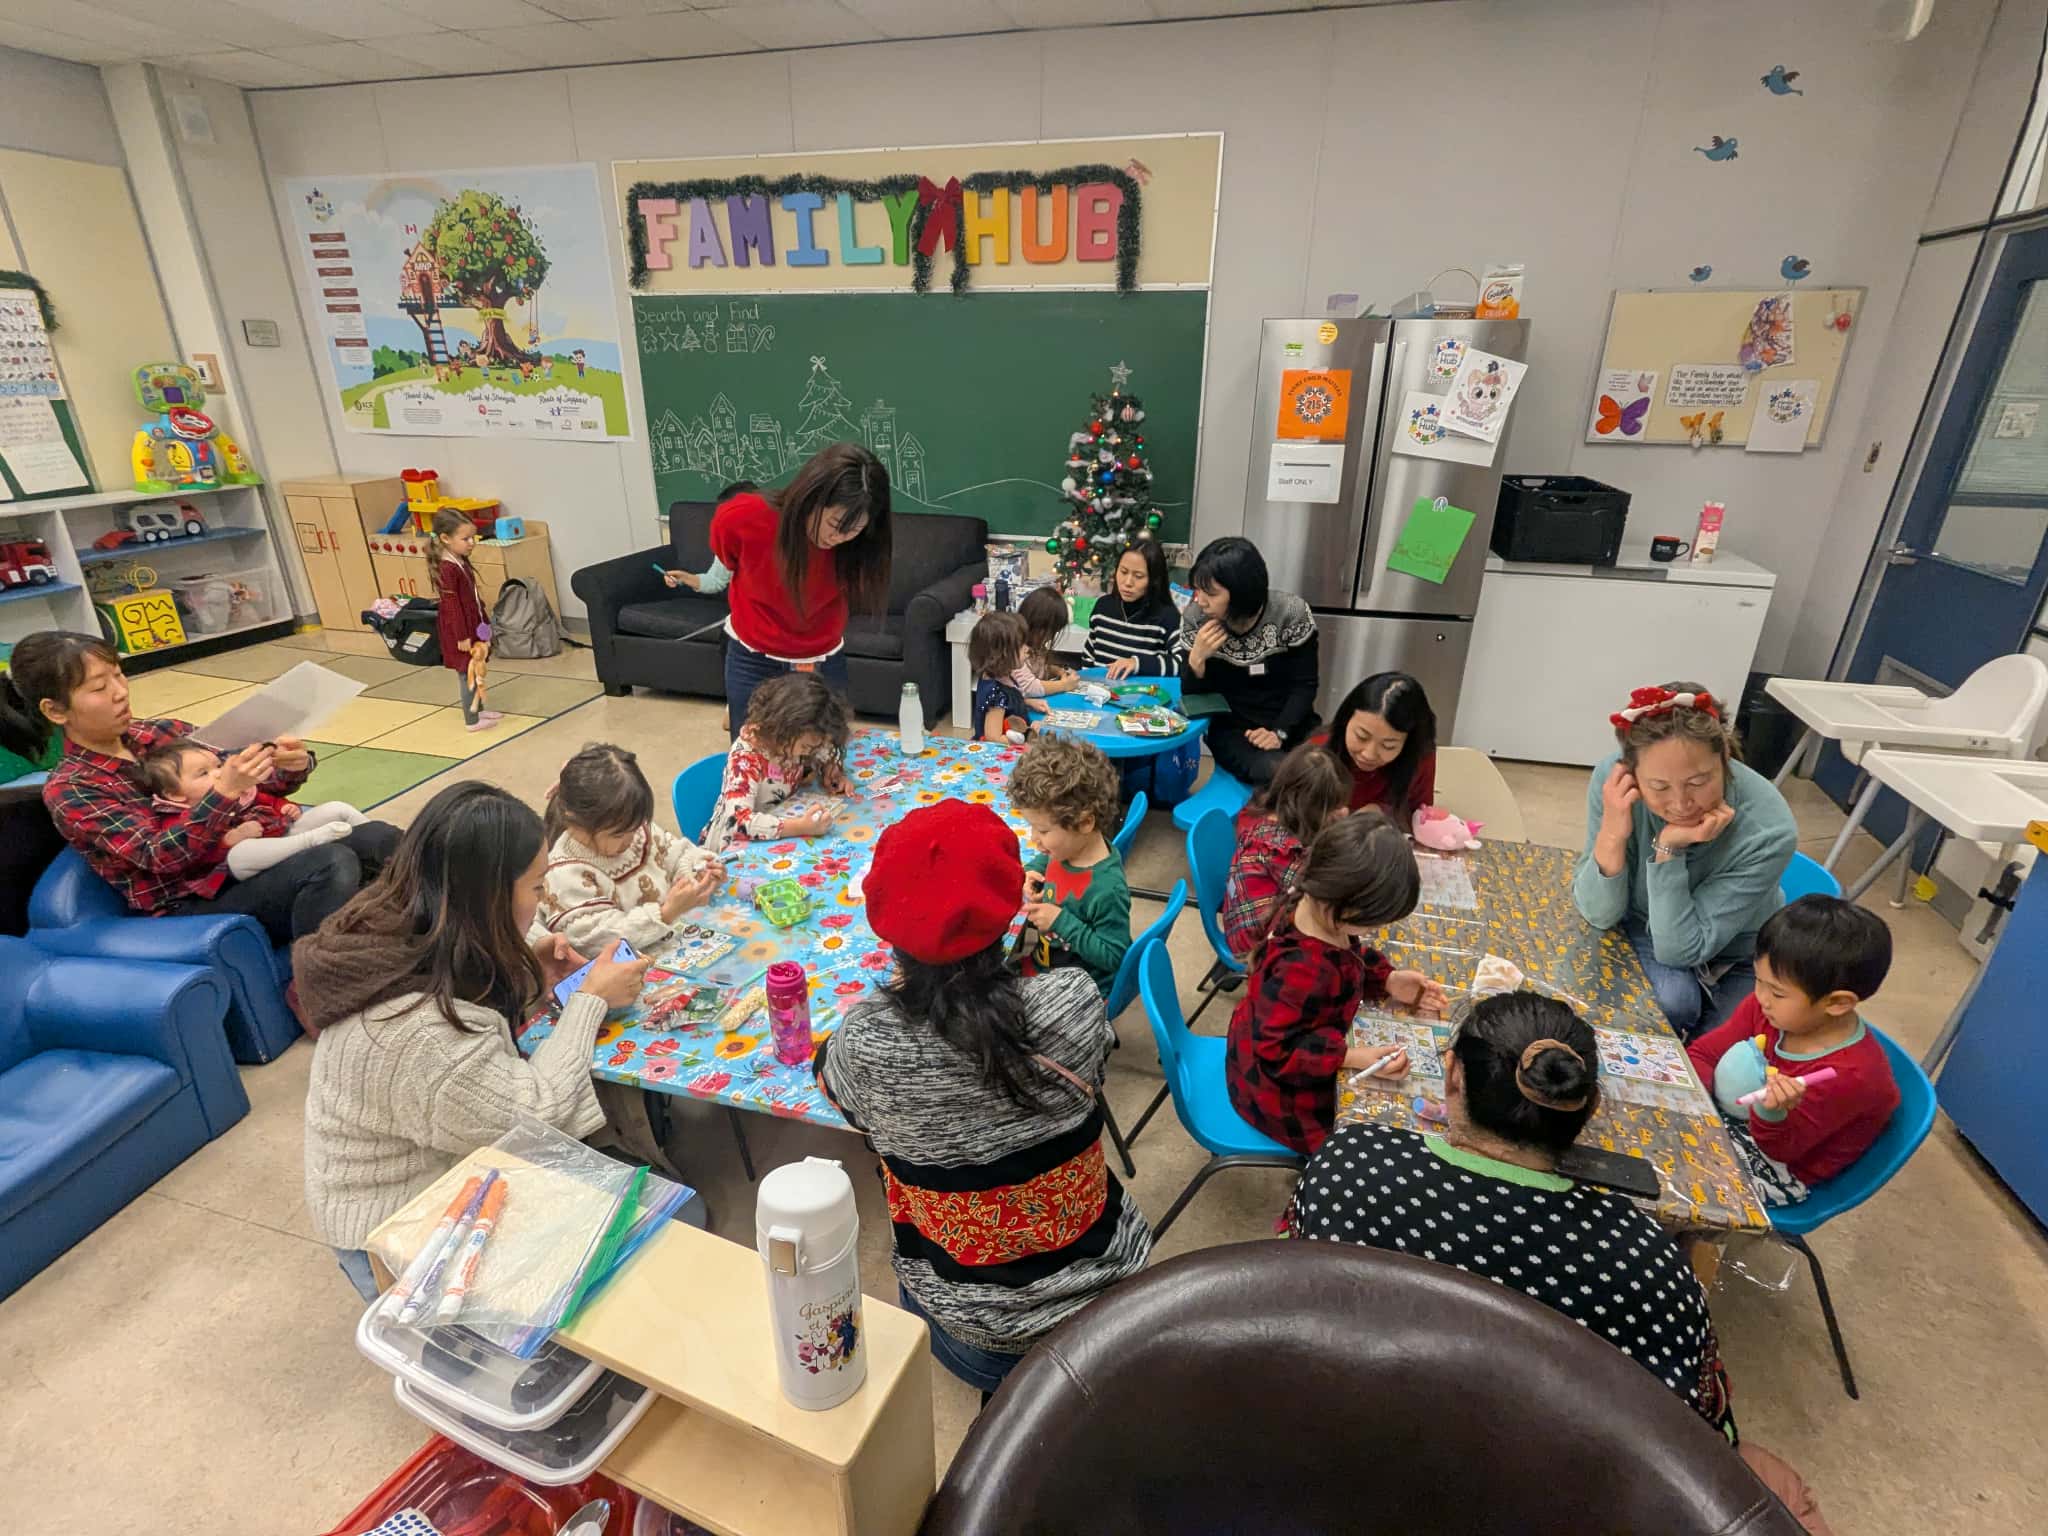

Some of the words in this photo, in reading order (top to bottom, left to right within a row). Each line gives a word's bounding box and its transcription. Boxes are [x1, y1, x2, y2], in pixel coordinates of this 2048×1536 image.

[638, 191, 919, 271] FAMILY
[962, 182, 1125, 266] HUB
[636, 304, 687, 324] Search
[693, 303, 720, 322] and
[729, 301, 760, 321] Find
[1439, 357, 1458, 365] Hub
[1306, 399, 1321, 410] 215
[1418, 422, 1437, 431] Hub
